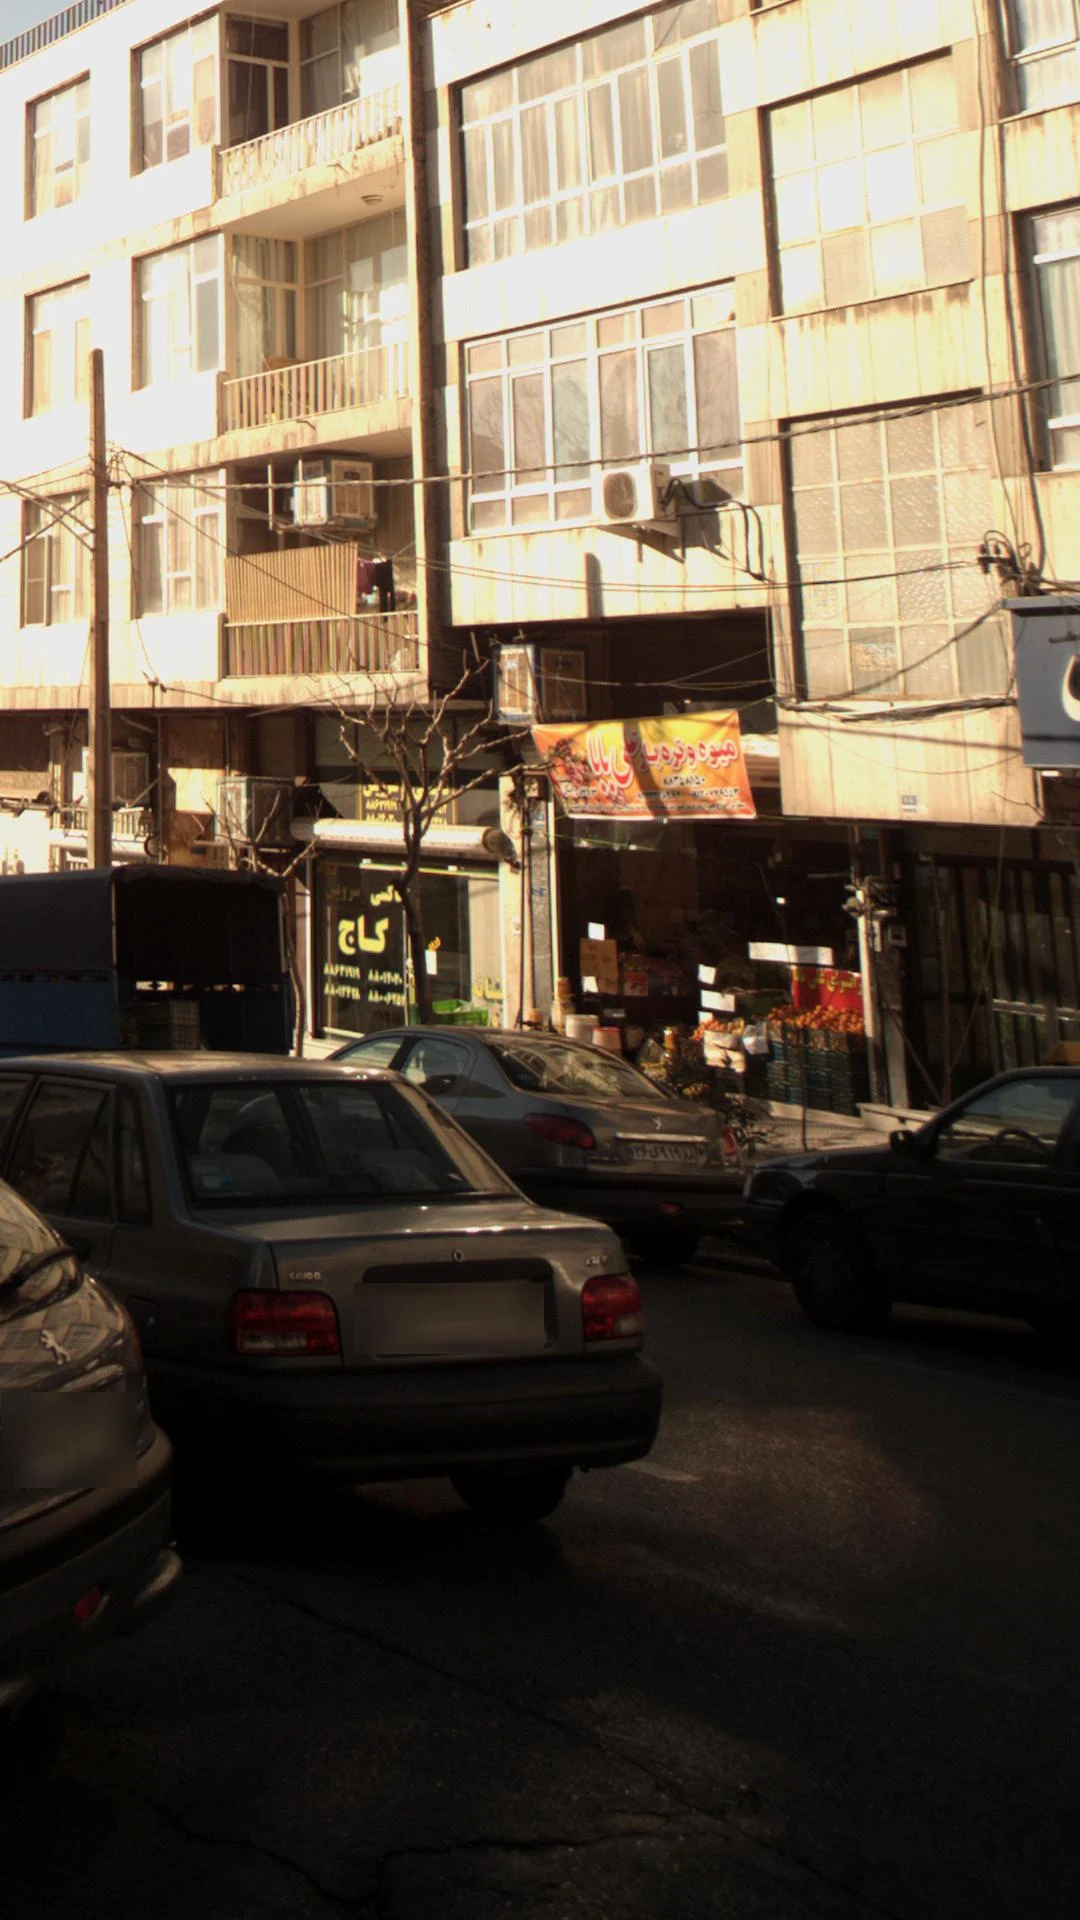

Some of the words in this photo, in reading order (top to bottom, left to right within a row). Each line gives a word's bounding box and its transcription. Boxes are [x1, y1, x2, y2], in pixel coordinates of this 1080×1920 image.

[699, 739, 738, 768] میوه
[370, 884, 402, 906] اکسی
[338, 914, 389, 955] کاج
